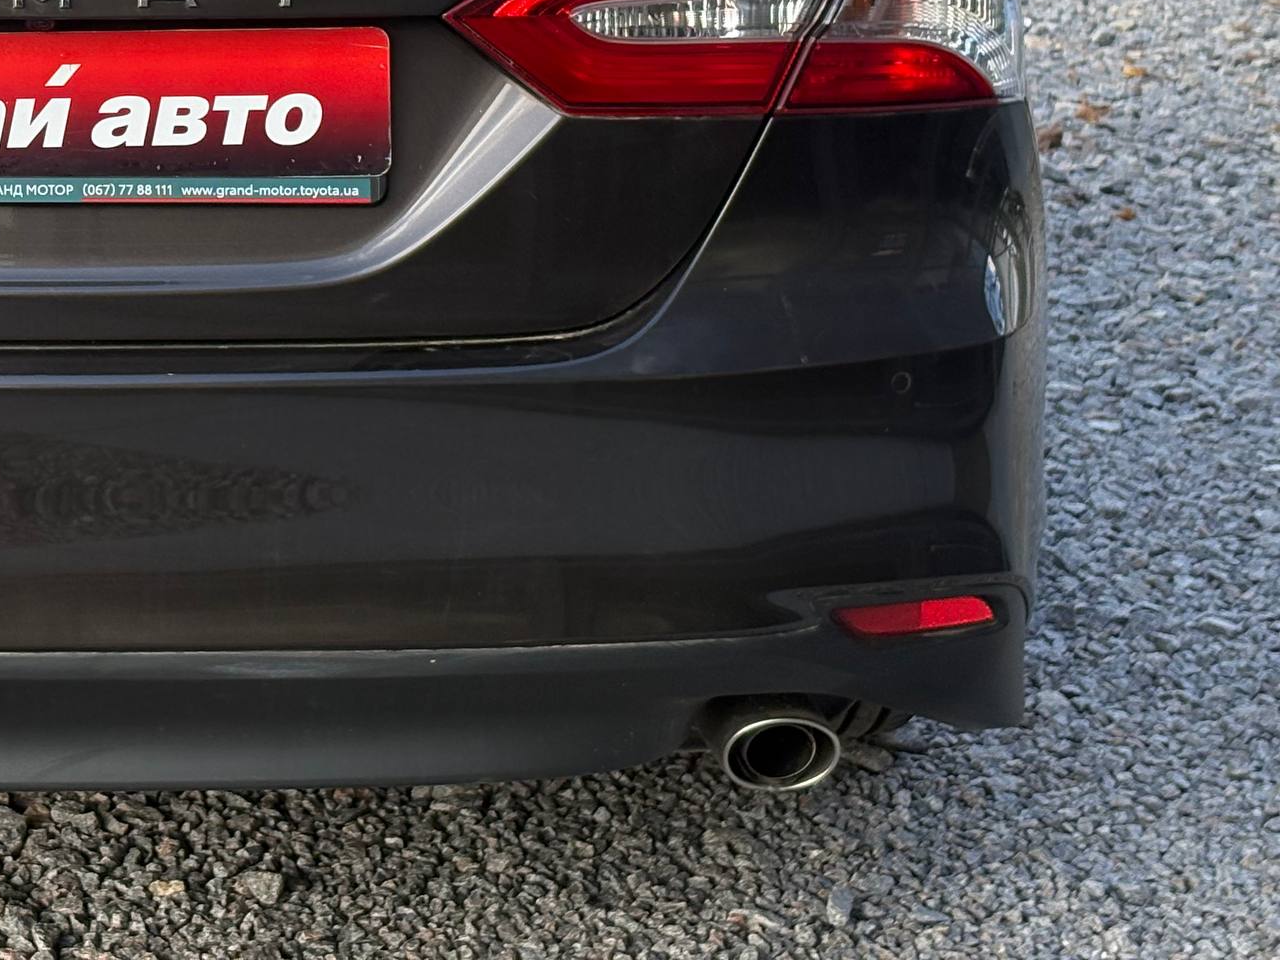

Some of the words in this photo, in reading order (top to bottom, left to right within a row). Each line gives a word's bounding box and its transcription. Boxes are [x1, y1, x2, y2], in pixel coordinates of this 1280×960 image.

[90, 92, 324, 149] авто
[26, 184, 74, 197] МОТОР
[82, 183, 116, 197] (067)
[118, 184, 134, 196] 77
[136, 184, 153, 196] 88
[155, 184, 172, 196] 111
[181, 183, 360, 198] www.grand-motor.toyota.ua
